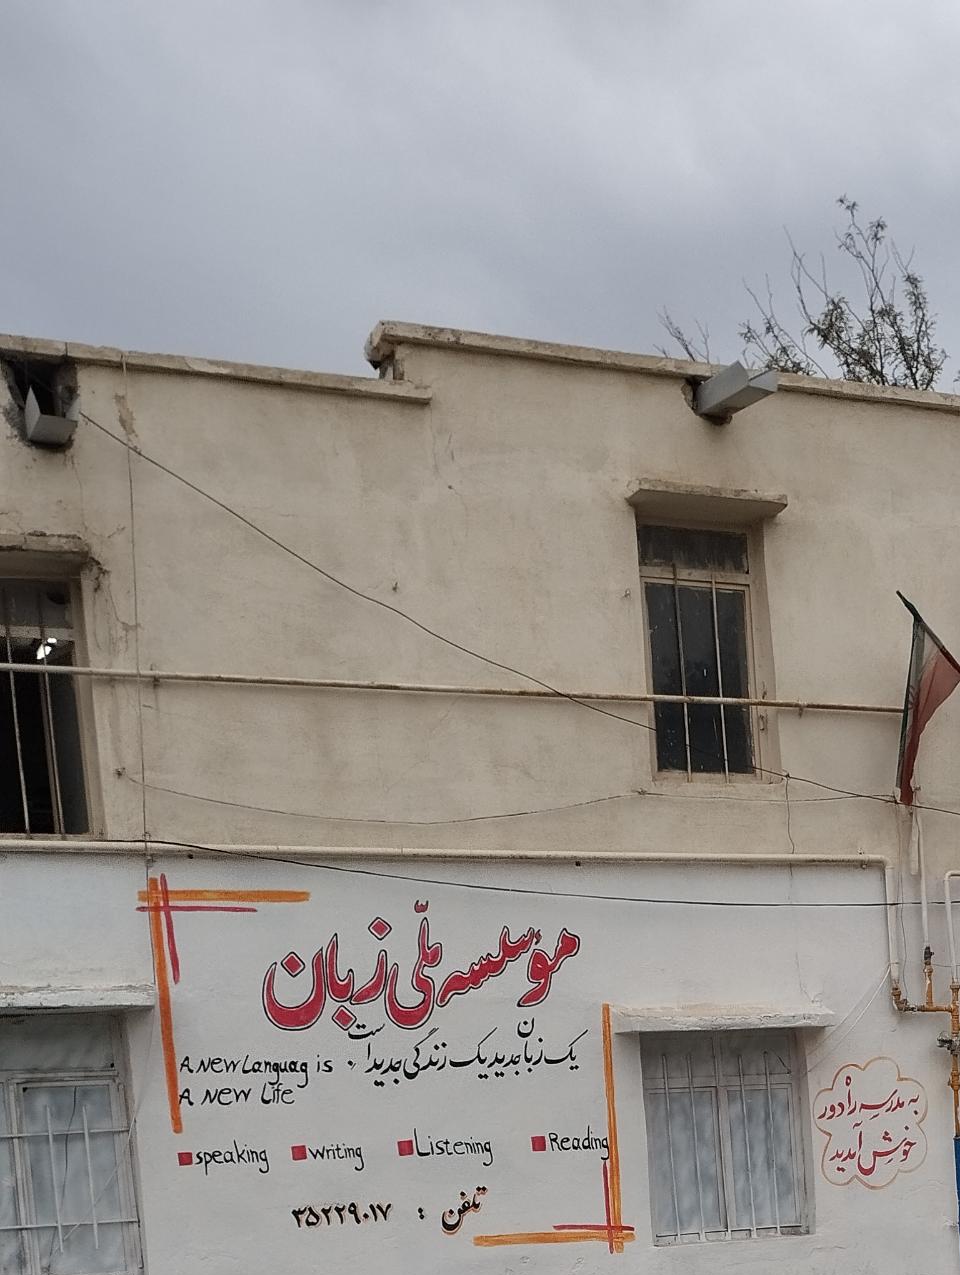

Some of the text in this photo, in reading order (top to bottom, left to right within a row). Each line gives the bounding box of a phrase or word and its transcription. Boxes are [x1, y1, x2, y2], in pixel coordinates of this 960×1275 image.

[262, 917, 392, 1032] زبان
[179, 1055, 194, 1074] A
[316, 1054, 334, 1073] is
[402, 1026, 448, 1081] زندگی
[449, 1026, 499, 1080] یک
[487, 1046, 522, 1079] جدید
[516, 1017, 545, 1074] زبان
[544, 1029, 590, 1072] یک
[178, 1087, 194, 1106] A
[261, 1082, 296, 1105] Life
[817, 1101, 845, 1120] دور
[907, 1094, 920, 1116] به
[195, 1139, 270, 1176] speaking
[413, 1128, 494, 1167] Listening
[548, 1124, 611, 1161] Reading
[829, 1120, 917, 1176] خوش آمدید
